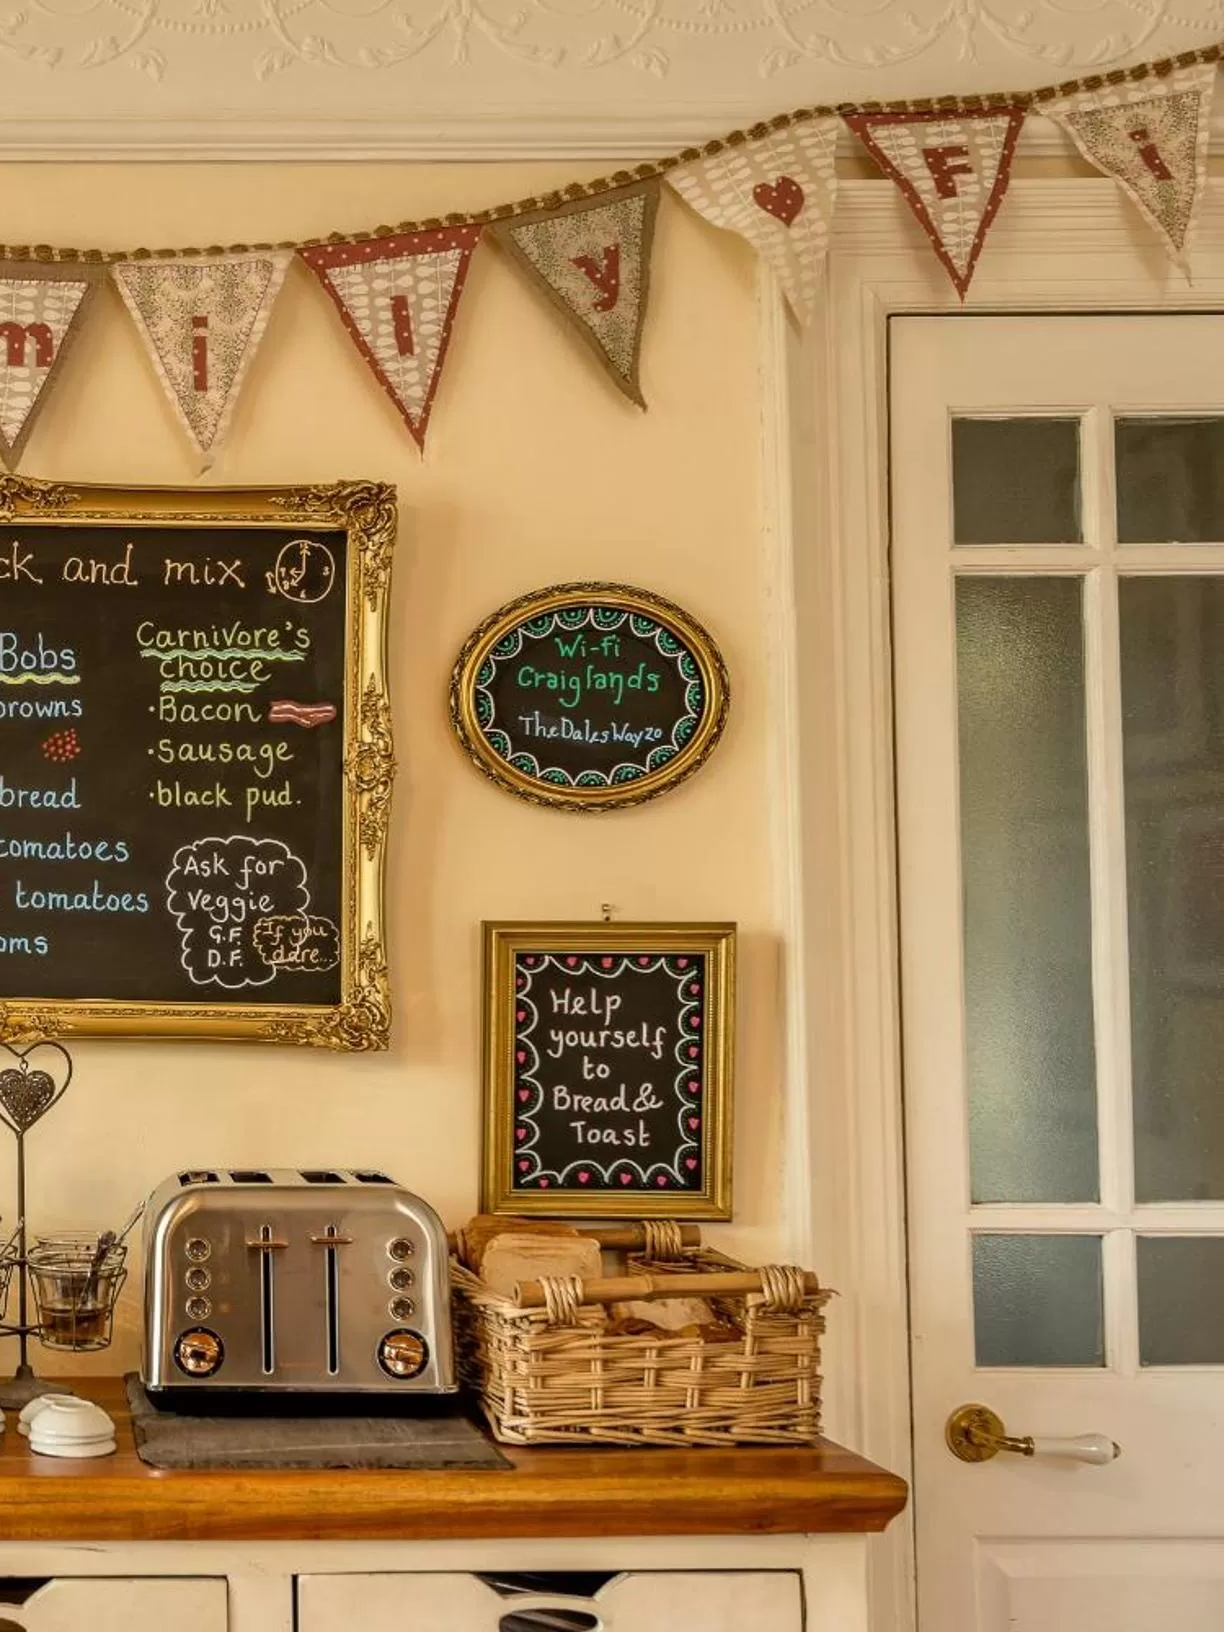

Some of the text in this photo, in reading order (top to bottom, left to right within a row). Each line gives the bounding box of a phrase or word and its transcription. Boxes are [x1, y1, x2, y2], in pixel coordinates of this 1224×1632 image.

[62, 543, 138, 585] and
[164, 553, 246, 587] mix
[160, 654, 271, 682] choice
[518, 662, 661, 708] Craiglands
[159, 695, 262, 722] Bacon
[157, 779, 302, 823] black pud.
[184, 852, 285, 890] Ask for
[15, 879, 149, 913] tomatoes
[187, 889, 274, 922] Veggie
[209, 925, 242, 946] G.F.
[262, 921, 328, 947] If you
[208, 949, 243, 967] D.F.
[550, 987, 622, 1026] Help
[547, 1022, 667, 1059] yourself
[582, 1056, 611, 1079] to
[569, 1119, 651, 1147] Toast
